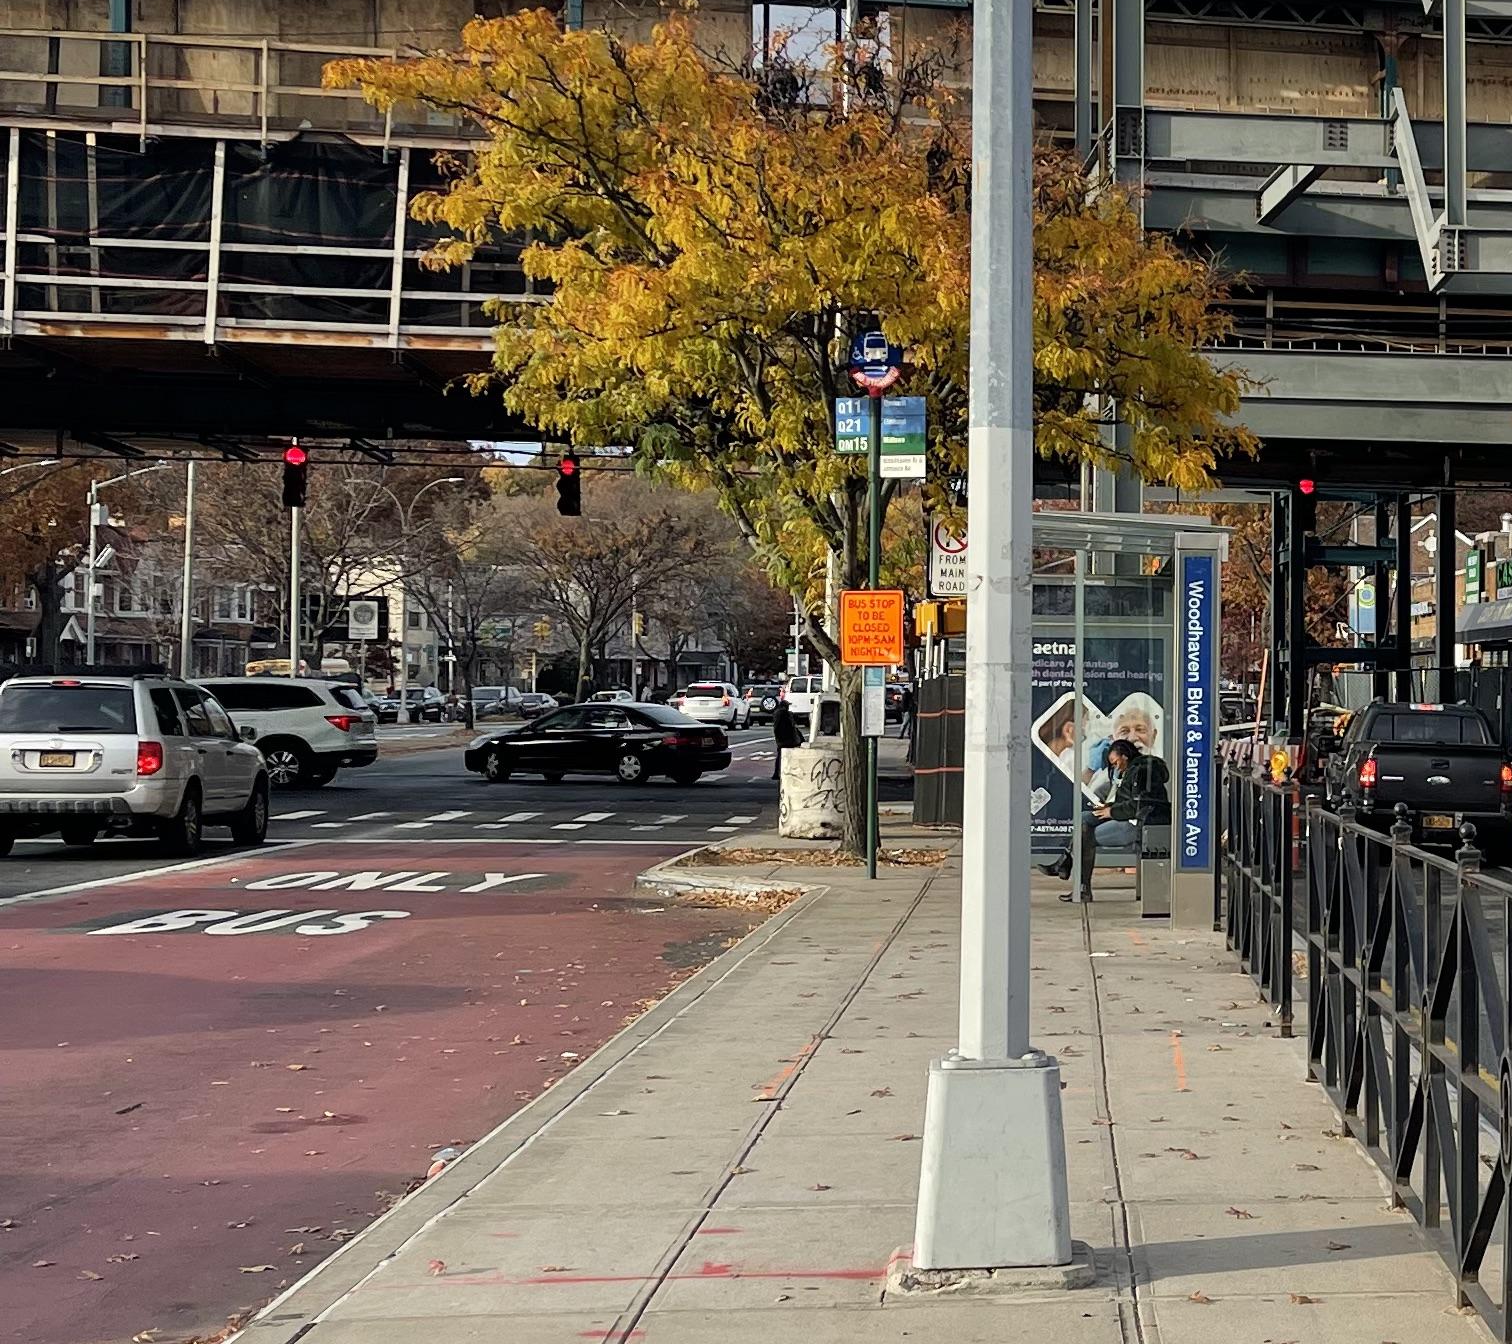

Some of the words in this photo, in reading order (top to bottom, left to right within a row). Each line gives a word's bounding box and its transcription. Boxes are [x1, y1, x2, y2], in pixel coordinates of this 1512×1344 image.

[838, 400, 861, 415] Q11
[838, 419, 861, 433] Q21
[838, 437, 868, 452] QM15
[939, 554, 966, 565] FROM
[940, 568, 965, 578] MAIN
[938, 581, 965, 592] ROAD
[848, 599, 867, 609] BUS
[869, 599, 895, 609] STOP
[857, 610, 870, 620] TO
[872, 610, 885, 620] BE
[852, 623, 890, 633] CLOSED
[1188, 580, 1204, 682] Woodhaven
[850, 647, 893, 657] NIGHTLY
[1032, 641, 1076, 655] aetna
[1107, 670, 1126, 679] and
[1187, 687, 1203, 725] Blvd
[1186, 730, 1203, 743] &
[1186, 746, 1202, 819] Jamaica
[1186, 824, 1201, 857] Ave
[245, 871, 548, 893] ONLY
[86, 909, 411, 935] BUS
